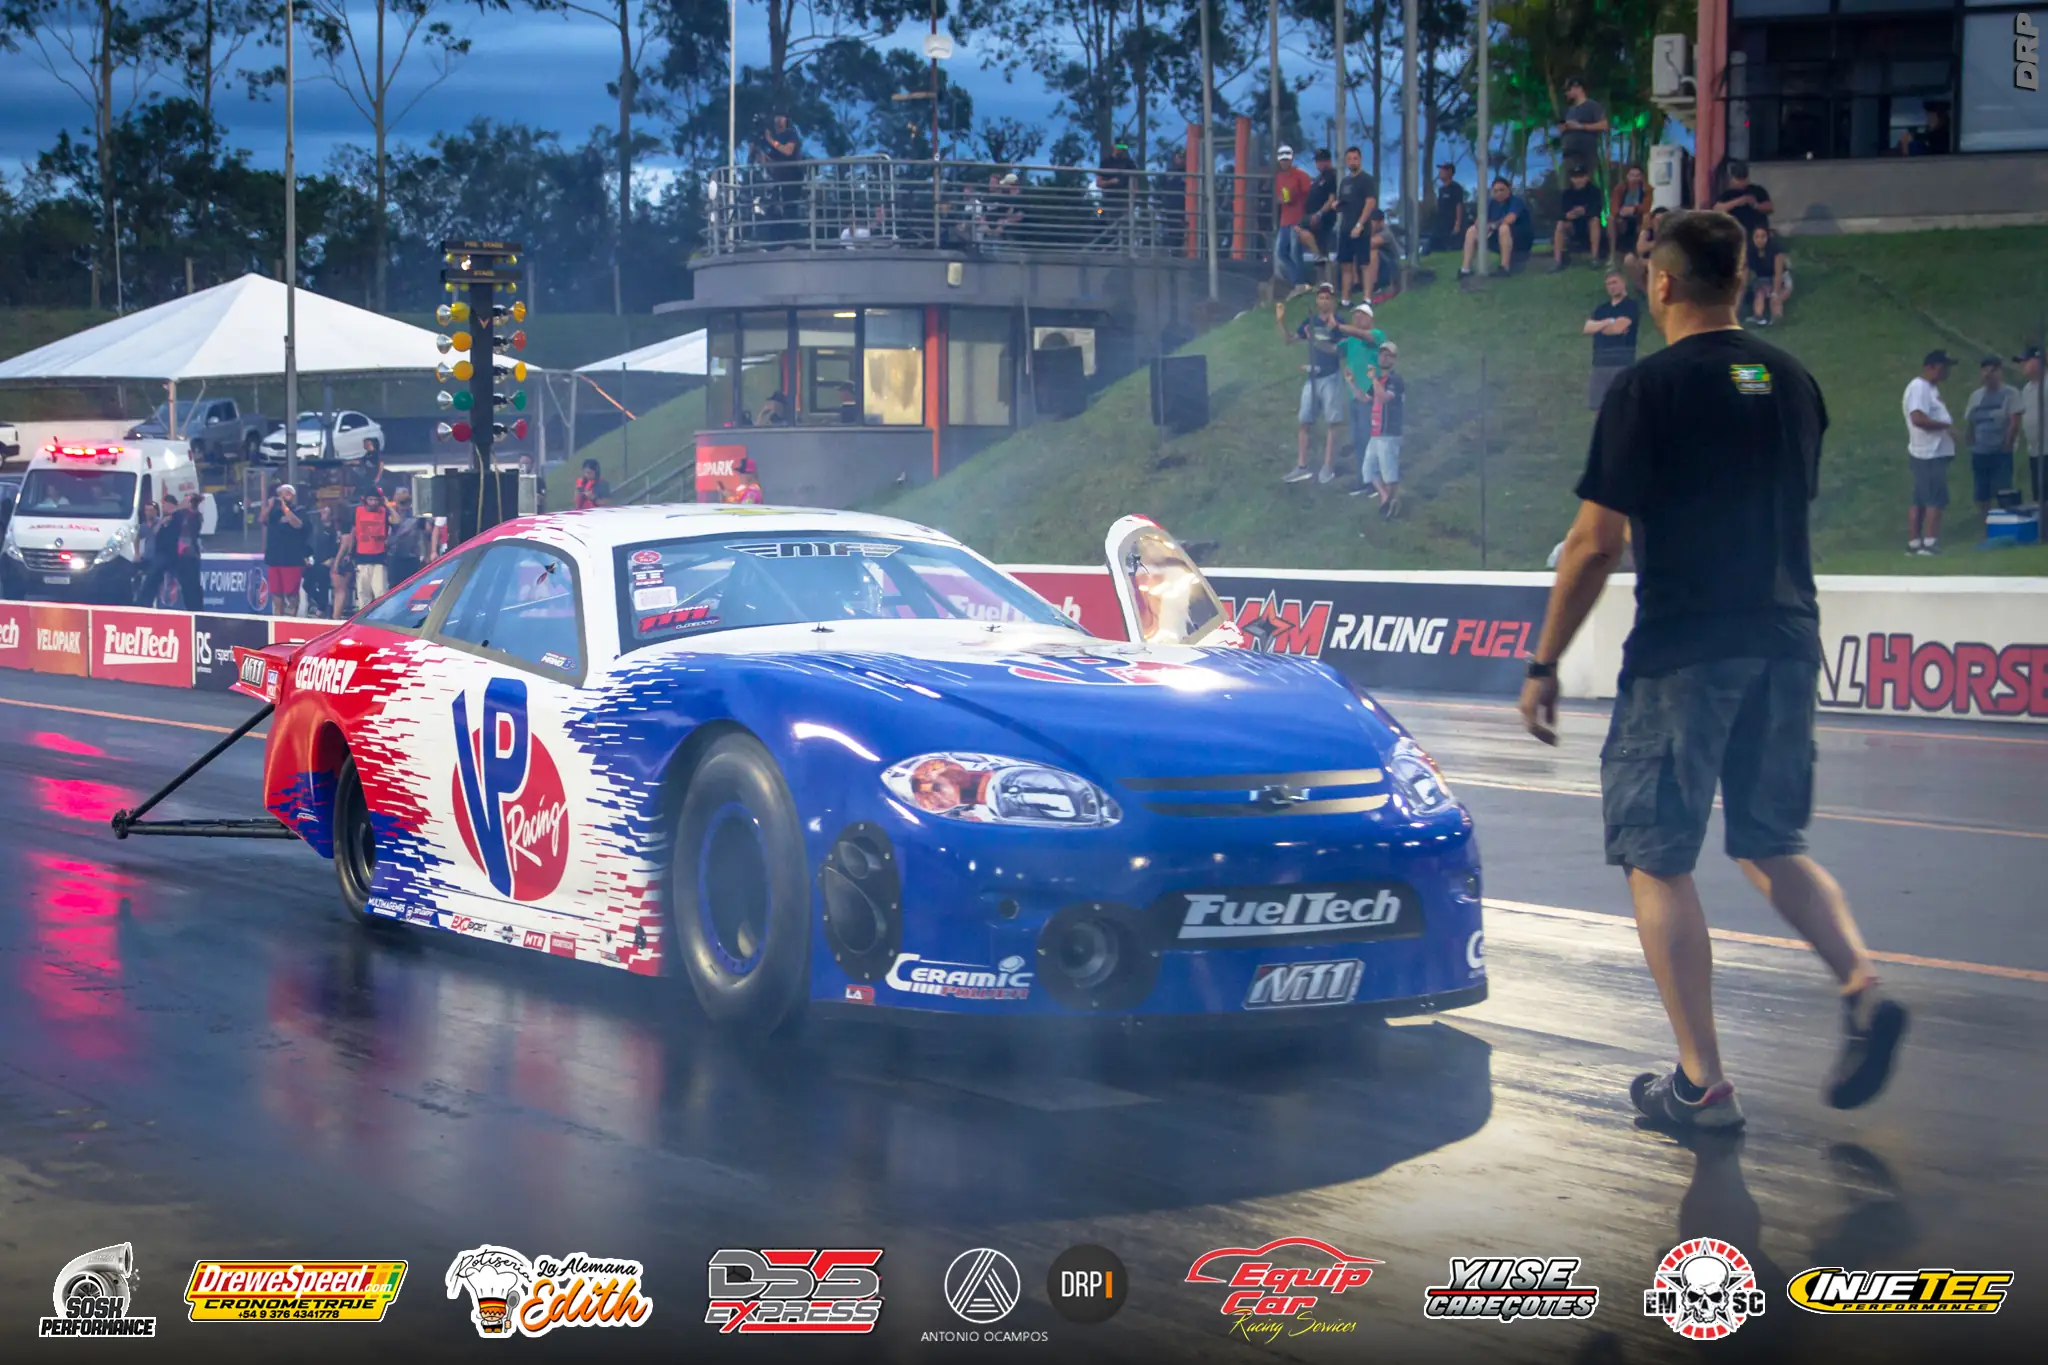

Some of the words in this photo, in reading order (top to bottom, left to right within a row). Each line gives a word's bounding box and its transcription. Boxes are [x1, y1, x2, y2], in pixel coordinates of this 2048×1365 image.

[37, 627, 81, 654] VELOPARK
[103, 623, 179, 665] FuelTech
[1330, 613, 1449, 654] RACING
[1449, 619, 1533, 660] FUEL
[295, 655, 346, 694] GEDORE
[452, 677, 529, 899] VP
[506, 794, 568, 872] Racing
[1178, 889, 1400, 939] FuelTech
[886, 952, 1035, 992] CERAMIC
